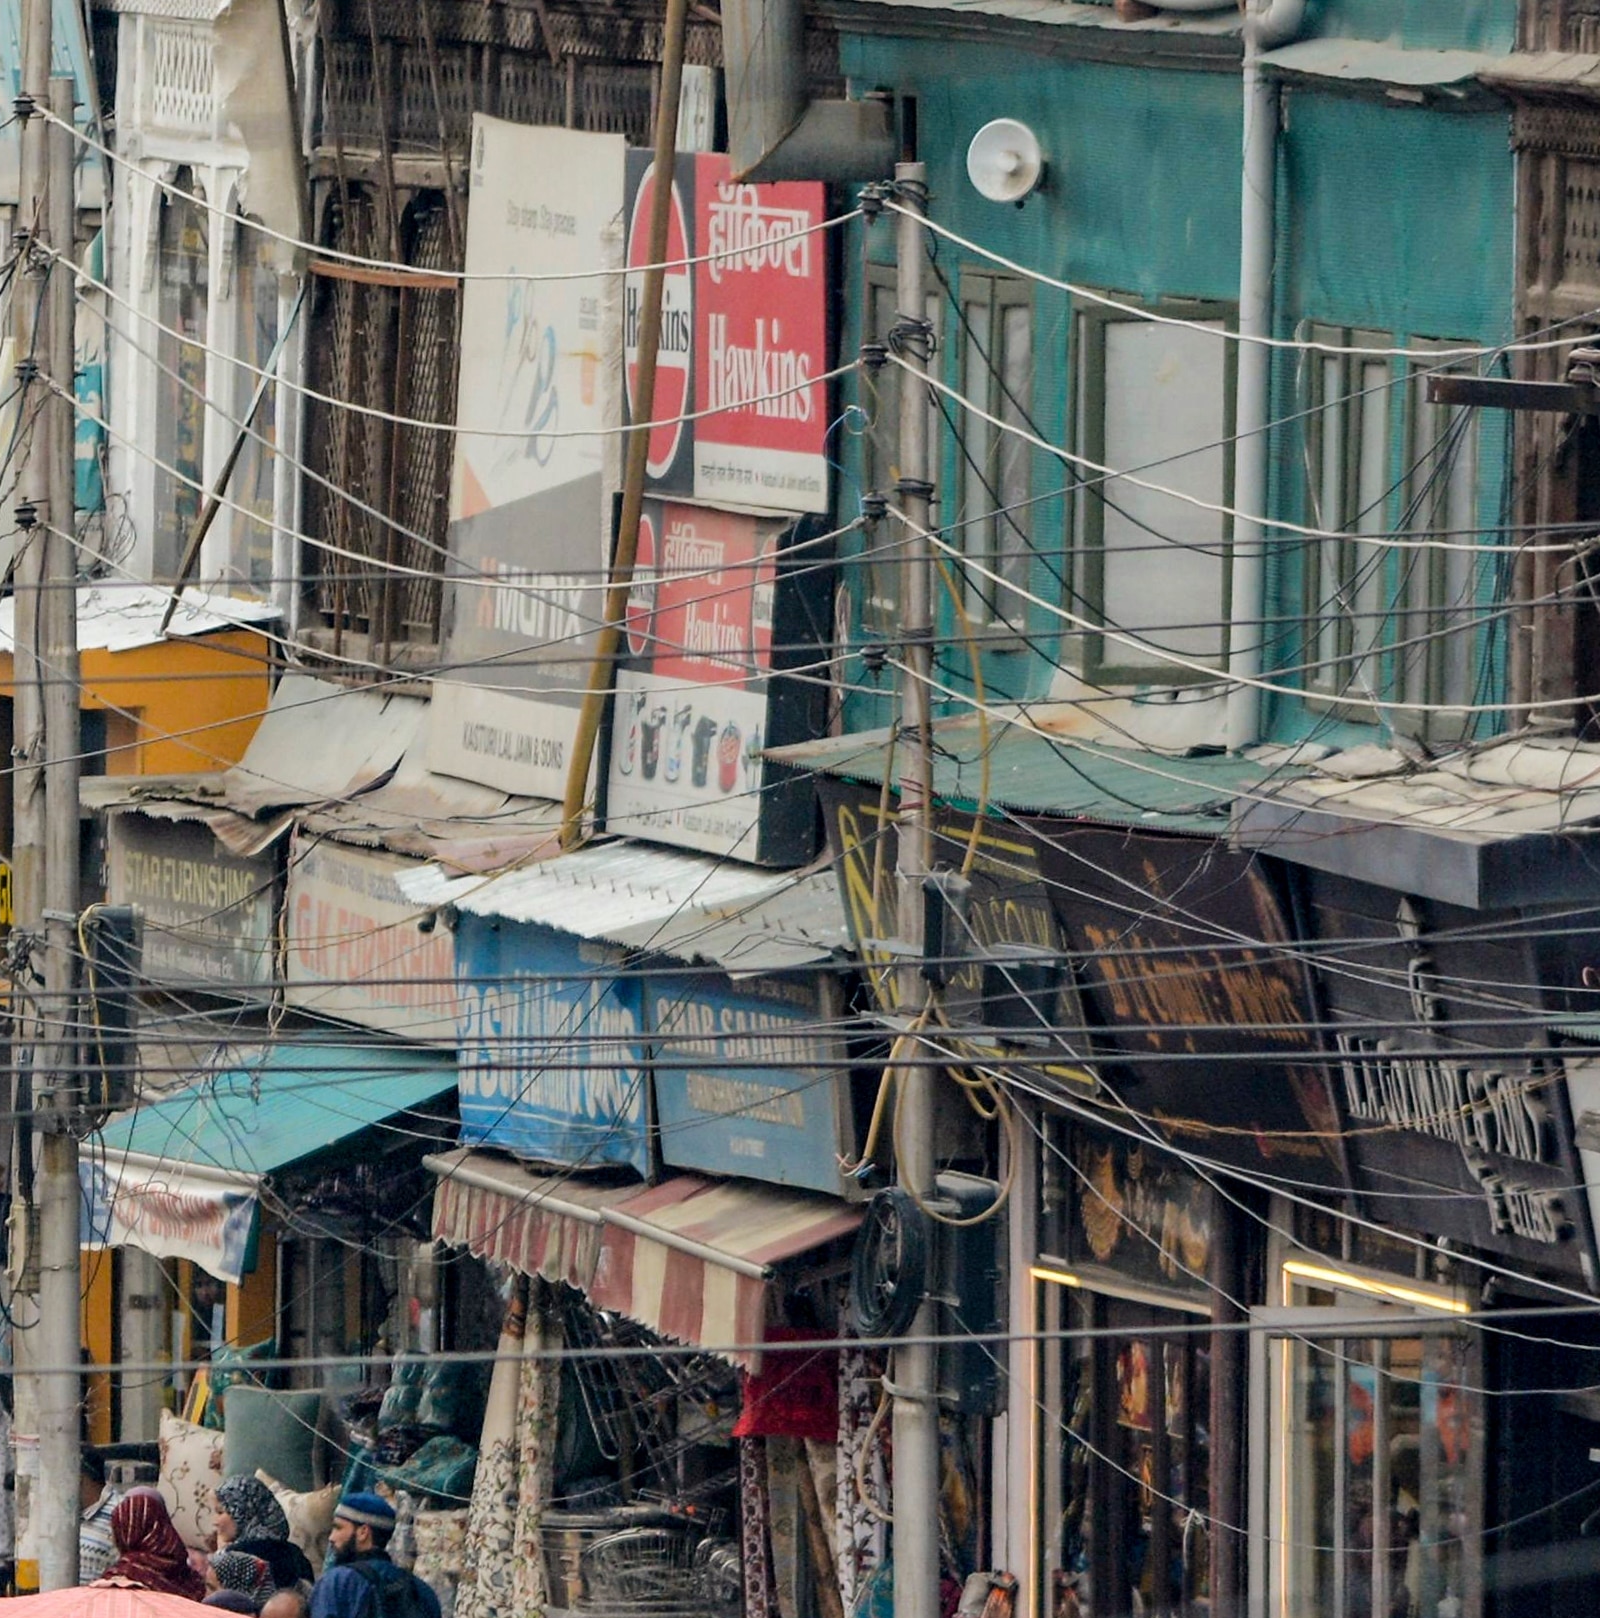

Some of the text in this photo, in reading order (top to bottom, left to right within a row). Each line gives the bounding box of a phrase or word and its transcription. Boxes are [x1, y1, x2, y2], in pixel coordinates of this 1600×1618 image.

[708, 313, 813, 423] Hawkins
[683, 599, 744, 673] Hawkins
[463, 719, 563, 770] KASTURI LAL JAIN & SONS
[123, 850, 161, 895] STAR
[163, 857, 256, 916] FURNISHING
